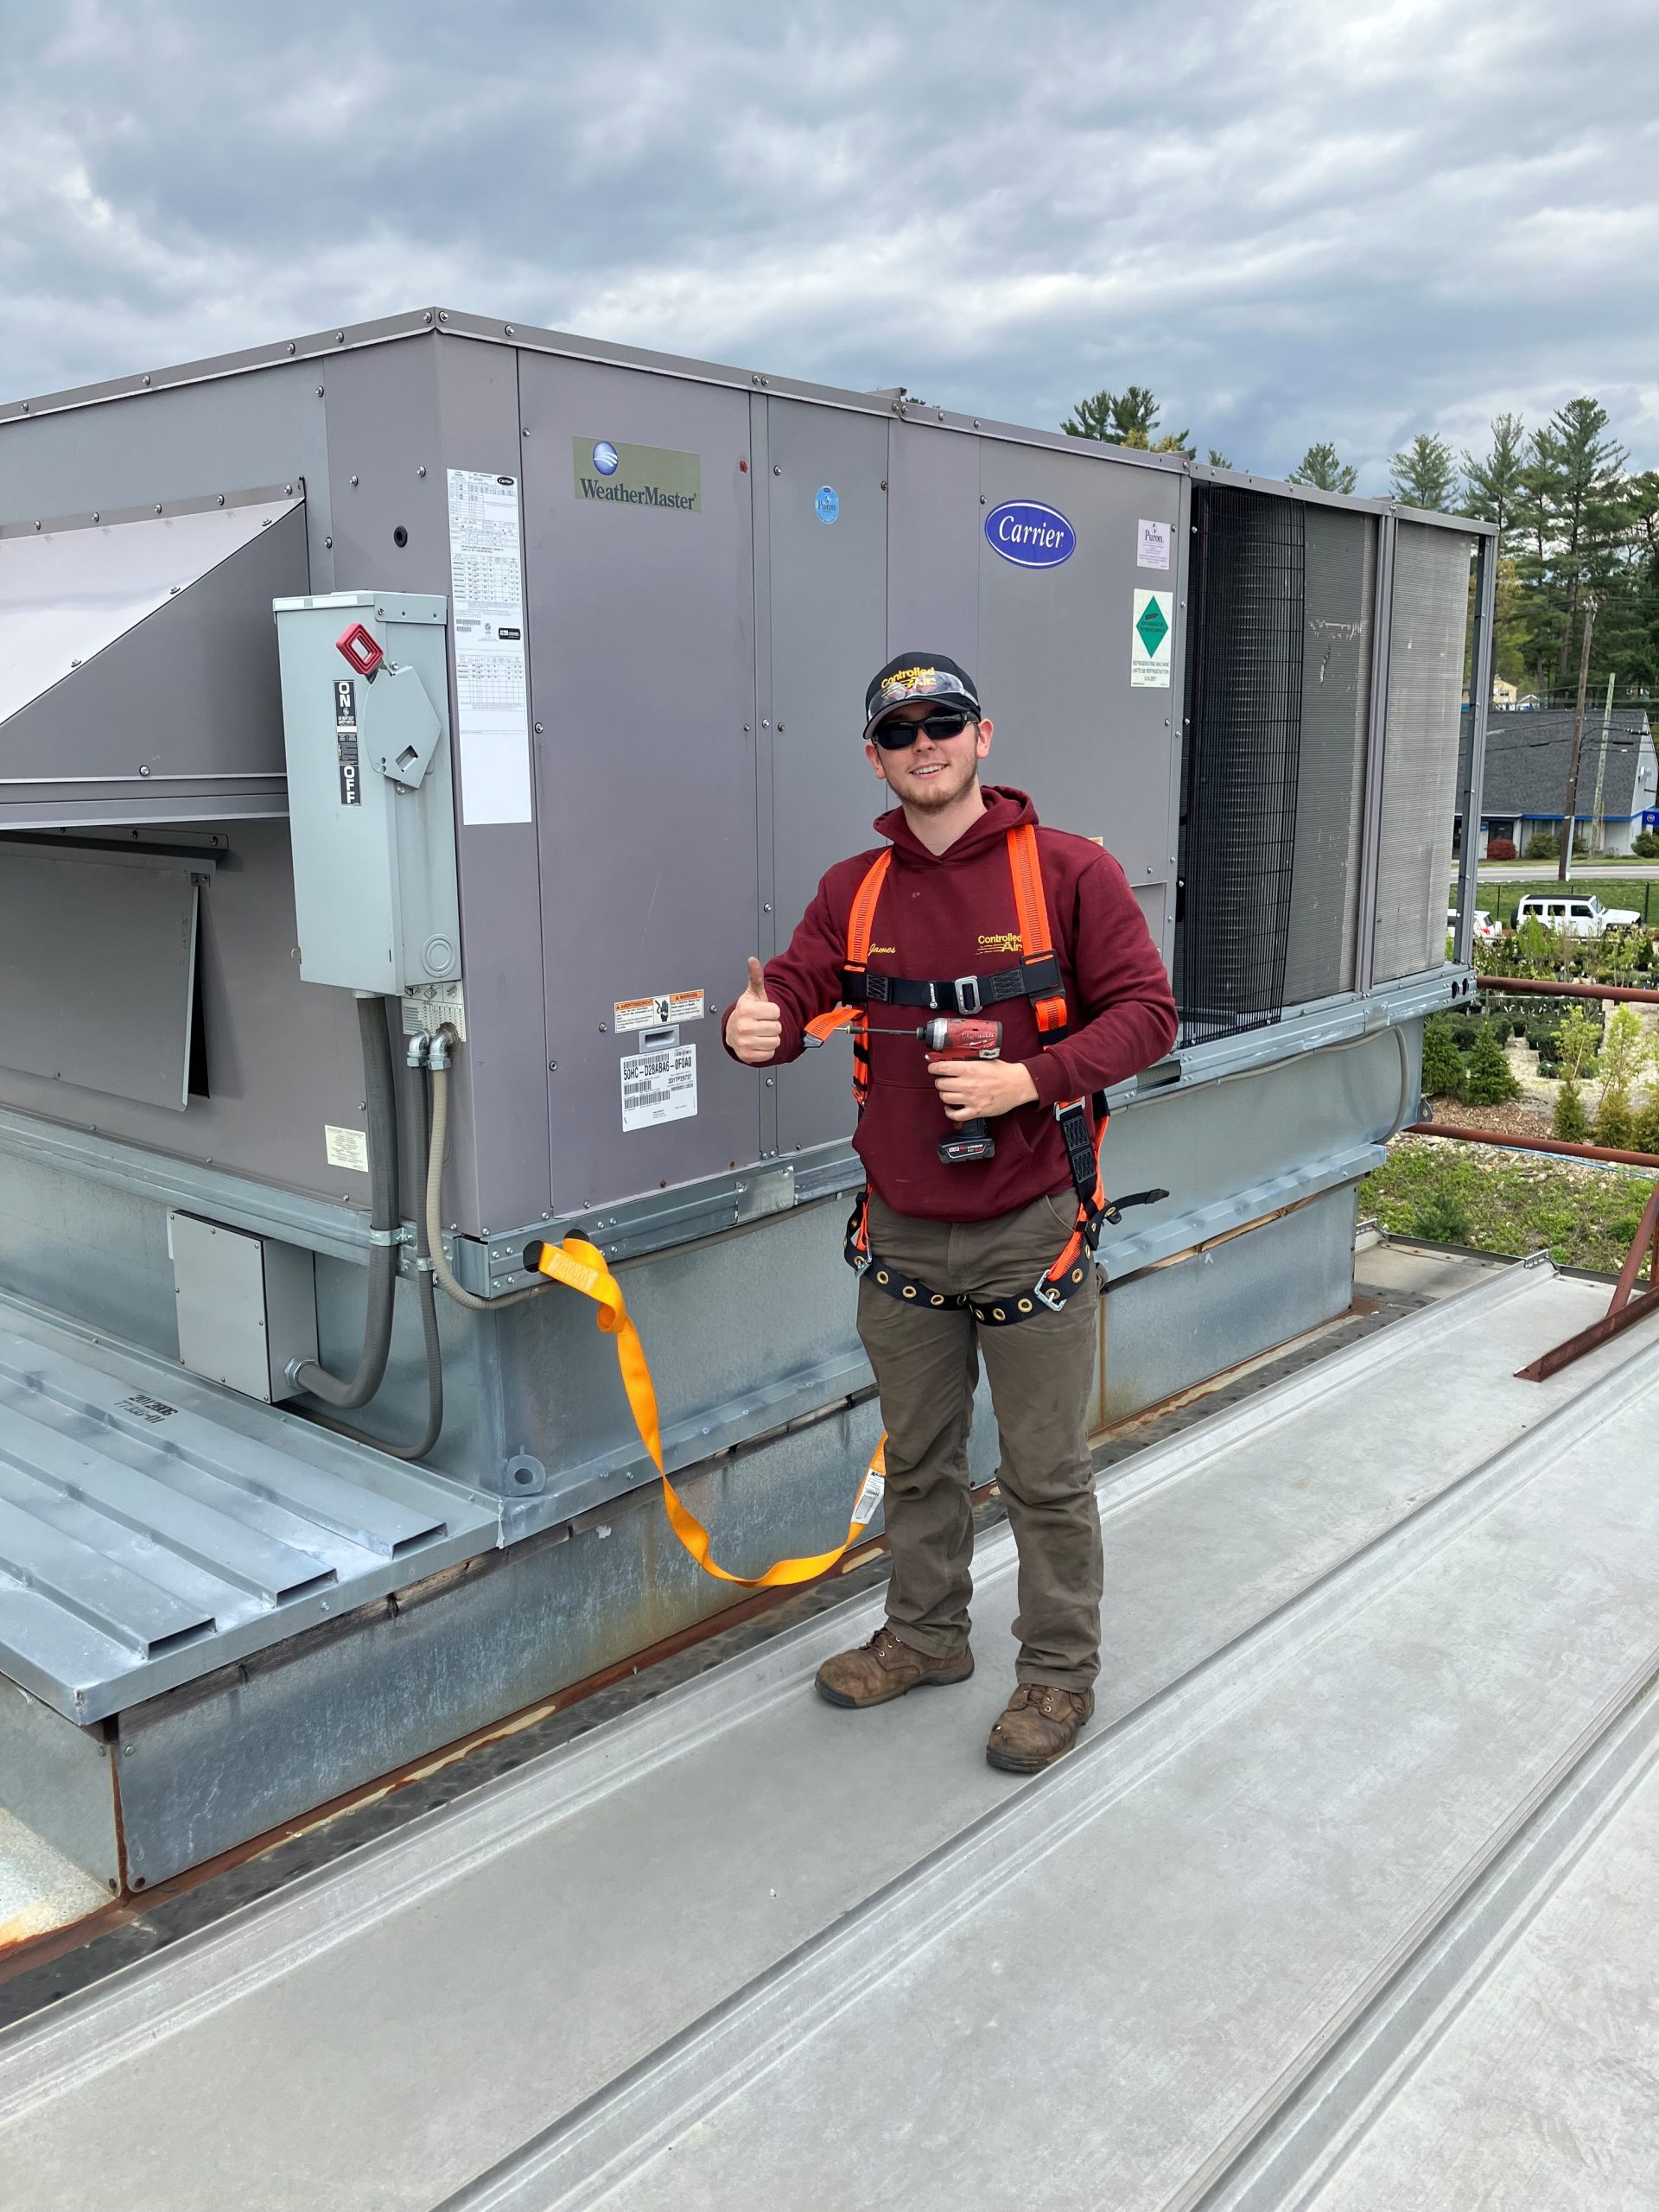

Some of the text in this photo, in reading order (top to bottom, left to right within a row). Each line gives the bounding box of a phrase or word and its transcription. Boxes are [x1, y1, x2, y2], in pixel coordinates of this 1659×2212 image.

[580, 478, 695, 510] WeatherMaster
[999, 516, 1065, 549] Carrier
[881, 667, 936, 689] Controlled
[339, 682, 351, 708] ON
[344, 766, 355, 804] OFF
[868, 943, 896, 957] James
